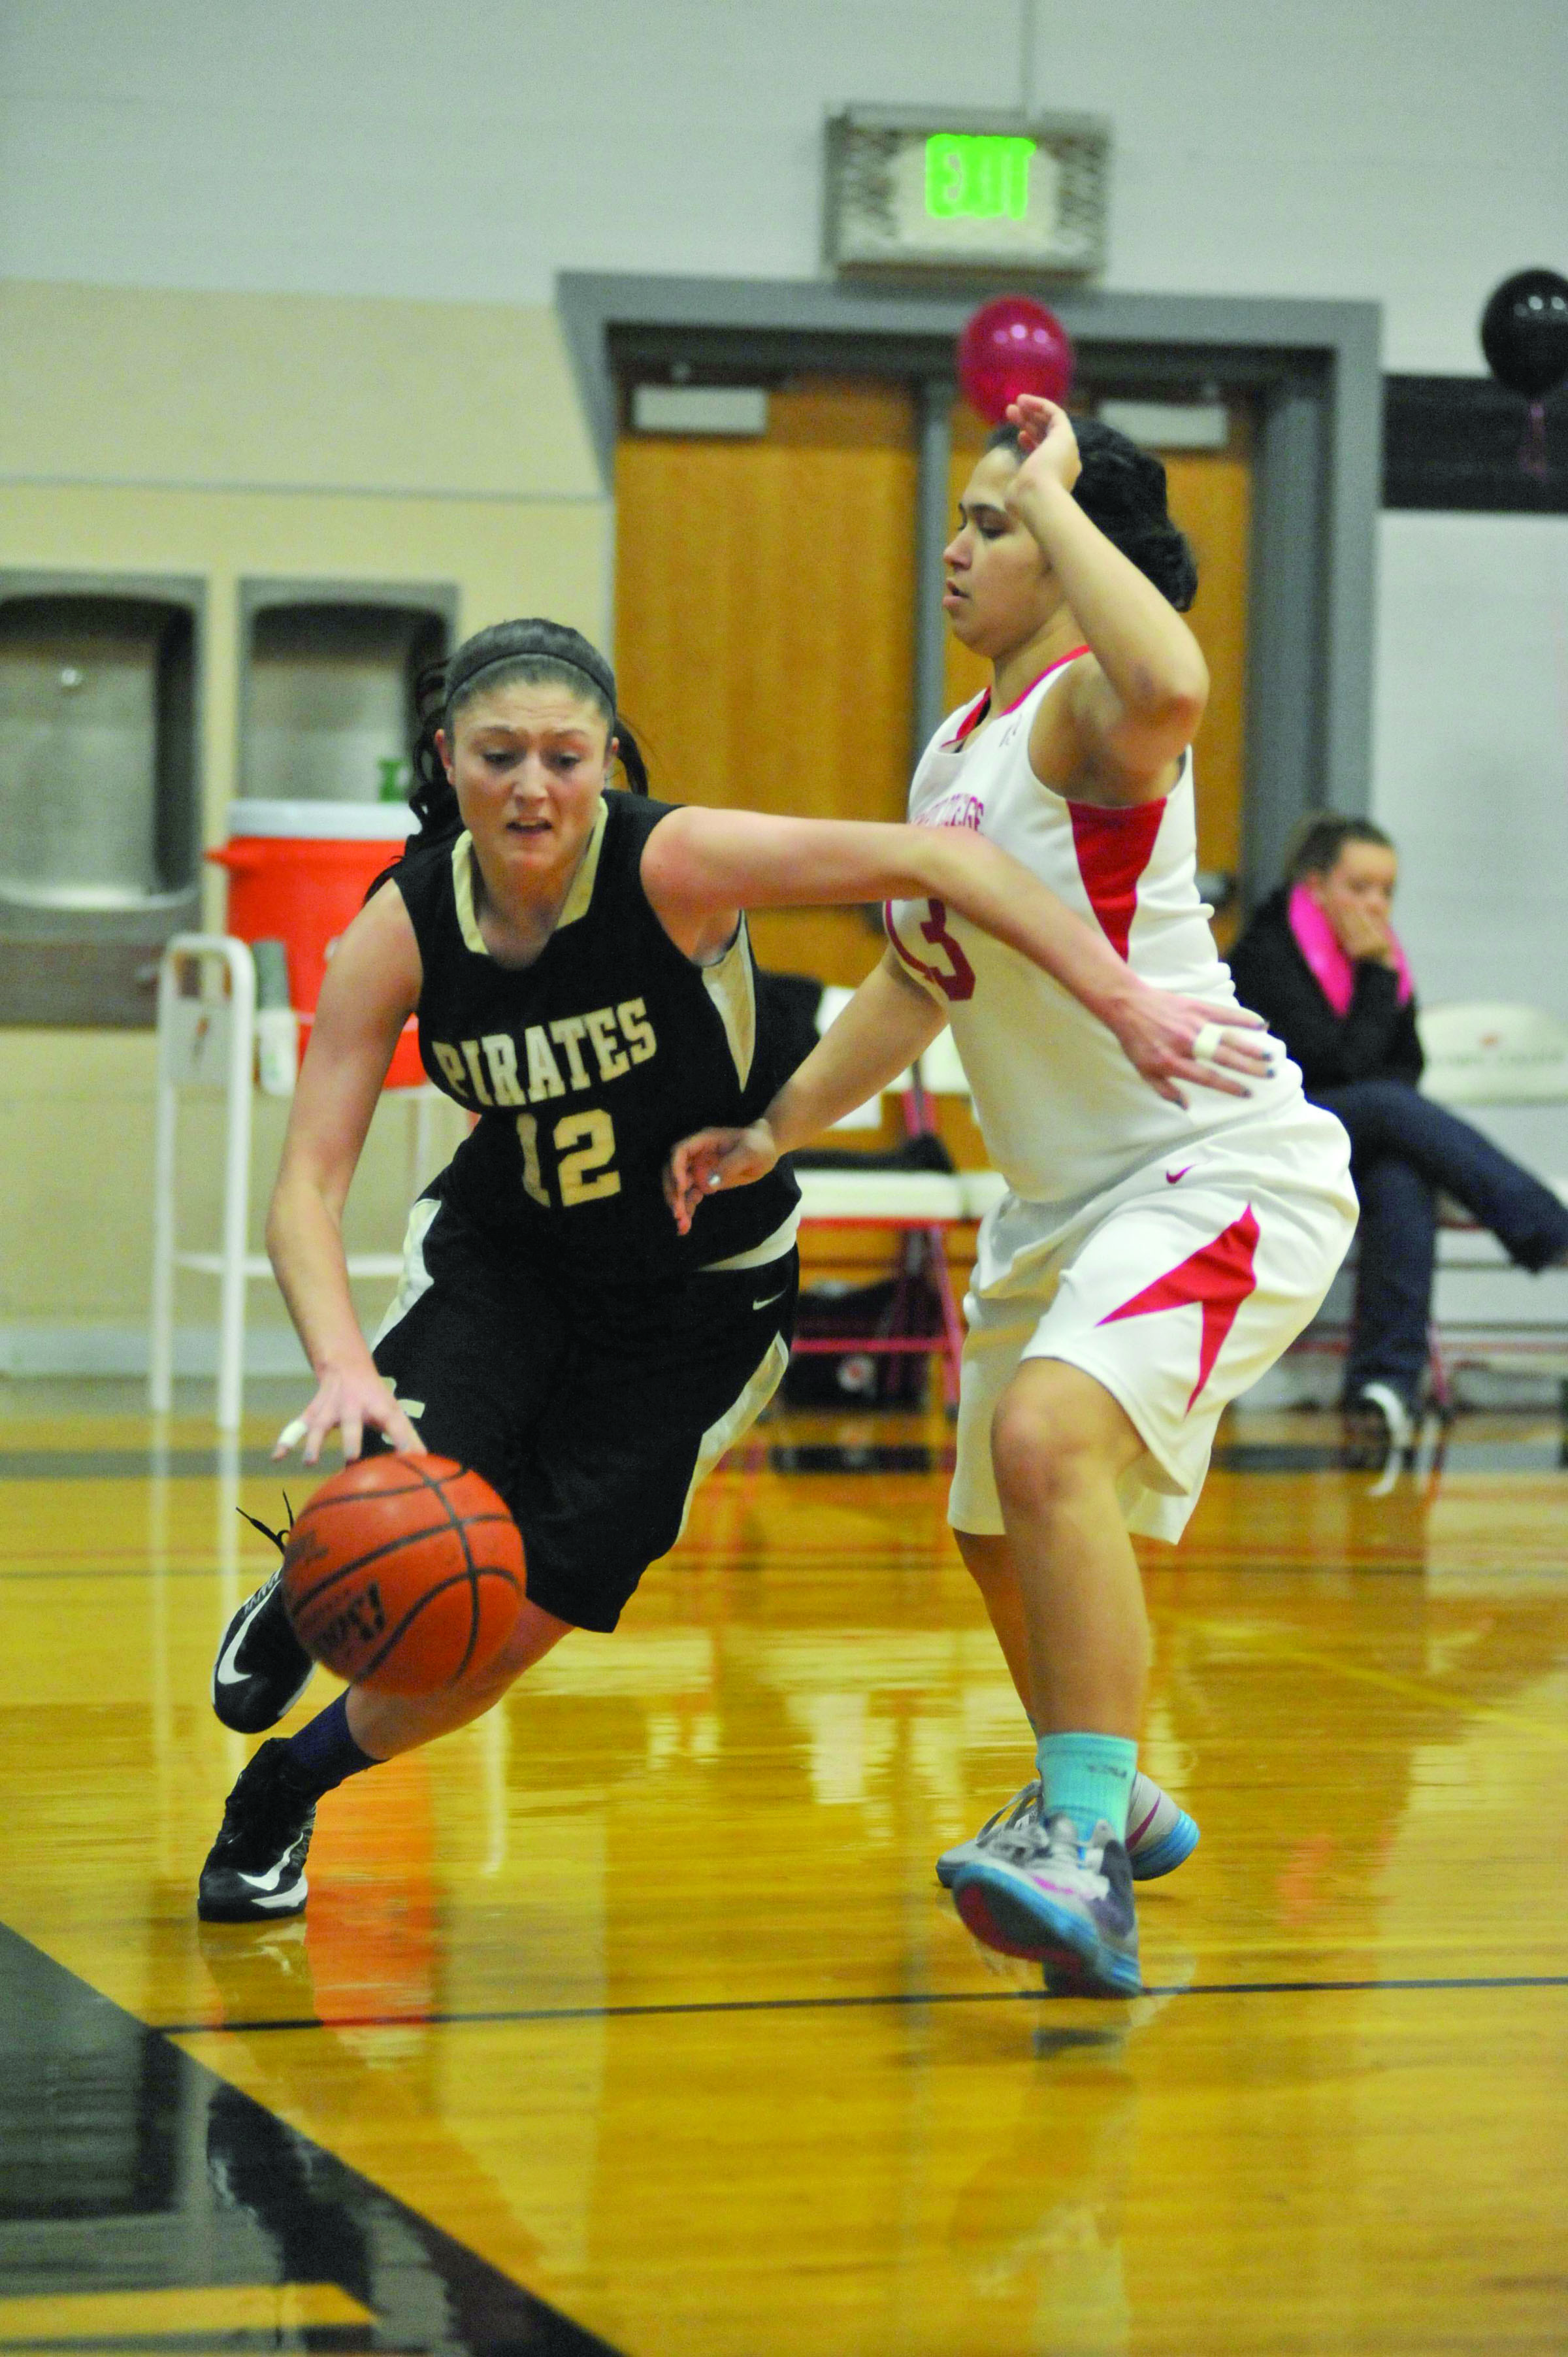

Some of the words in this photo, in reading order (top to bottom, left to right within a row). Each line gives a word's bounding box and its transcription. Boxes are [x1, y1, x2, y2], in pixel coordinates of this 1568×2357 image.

[925, 133, 1037, 220] EXIT
[432, 997, 657, 1107] PIRATES
[516, 1108, 622, 1208] 12
